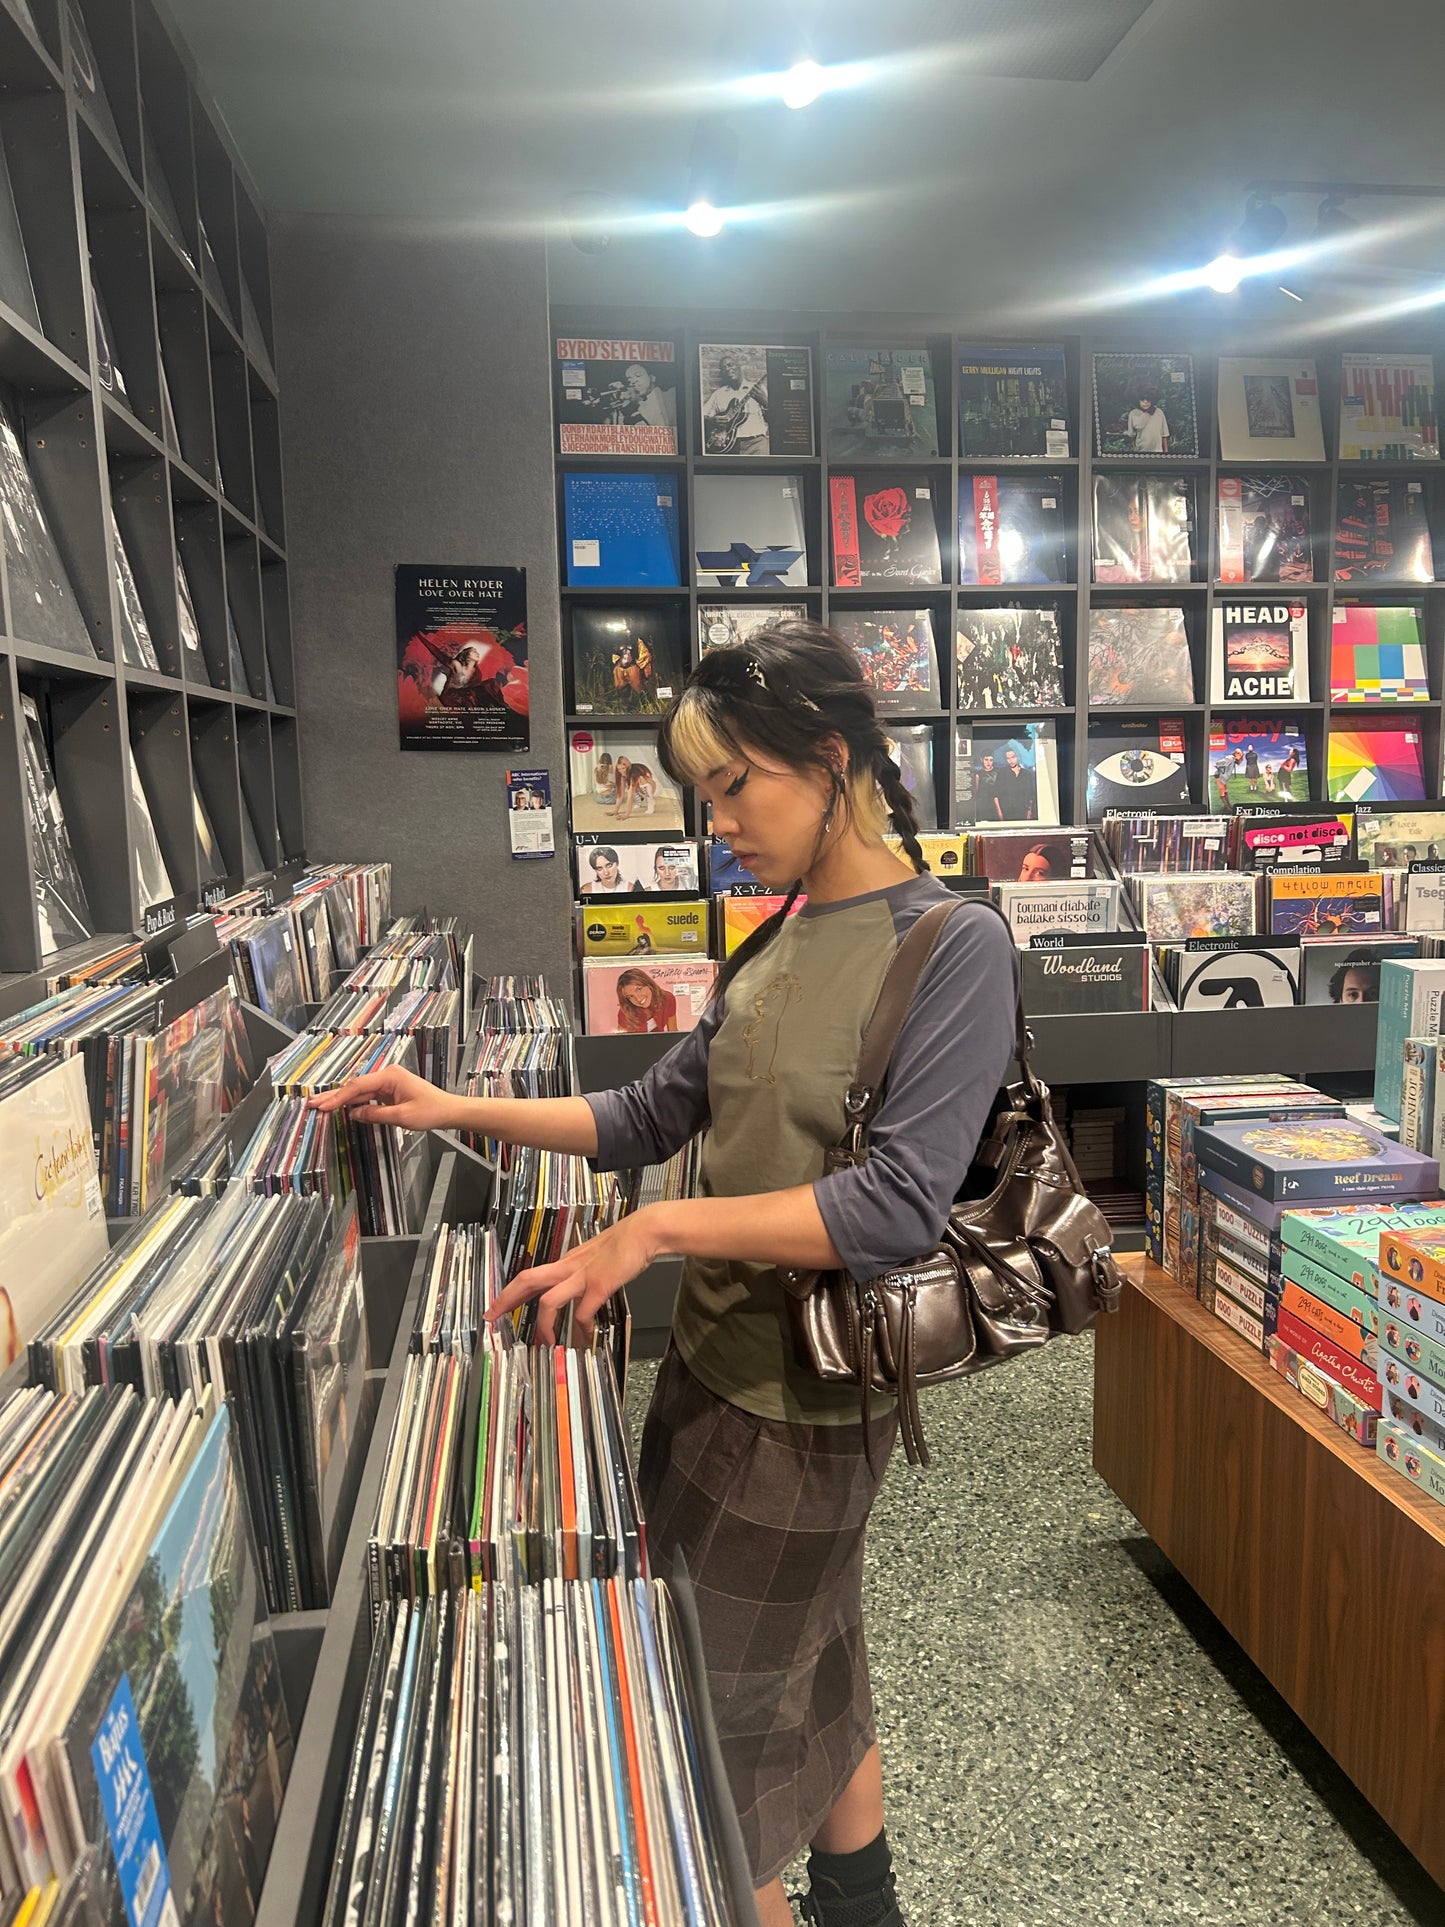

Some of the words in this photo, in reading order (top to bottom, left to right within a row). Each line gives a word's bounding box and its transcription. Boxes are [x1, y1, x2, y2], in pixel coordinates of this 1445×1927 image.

[419, 578, 458, 589] HELEN
[464, 579, 504, 590] RYDER
[419, 589, 445, 598] LOVE
[448, 590, 475, 598] OVER
[479, 590, 504, 599] HATE
[1226, 605, 1290, 624] HEAD
[1227, 677, 1291, 696] ACHE
[1228, 715, 1283, 743] glory
[1106, 808, 1157, 818] Electronic
[1255, 806, 1280, 816] Disco
[1355, 804, 1372, 814] Jazz
[1253, 834, 1286, 845] disco
[1289, 829, 1309, 841] not
[1312, 827, 1344, 839] disco
[1266, 864, 1321, 875] Compilation
[582, 896, 592, 906] T
[1017, 901, 1058, 914] toumani
[1060, 899, 1101, 912] diabate
[146, 914, 157, 934] Pop
[162, 905, 176, 925] Rock
[667, 912, 700, 926] suede
[1017, 913, 1056, 925] ballake
[1058, 912, 1101, 924] sissoko
[1033, 937, 1065, 948] World
[1189, 940, 1240, 952] Electronic
[1041, 955, 1123, 976] Woodland
[1334, 959, 1371, 968] squarepusher
[1081, 974, 1122, 982] STUDIOS
[1430, 990, 1440, 1022] Puzzle
[1428, 1023, 1438, 1038] Ma
[1407, 1077, 1418, 1117] JOHN
[1334, 1172, 1362, 1185] Reef
[1363, 1171, 1404, 1184] Dream
[1218, 1207, 1235, 1225] 1000
[1243, 1222, 1268, 1246] PUZZLE
[1348, 1216, 1411, 1235] 299
[1300, 1230, 1315, 1245] 299
[1314, 1237, 1328, 1254] DOGS
[1219, 1234, 1235, 1253] 1000
[1242, 1251, 1267, 1276] PUZZLE
[1300, 1264, 1314, 1279] 299
[1314, 1271, 1328, 1289] DOGS
[1217, 1267, 1232, 1286] 1000
[1239, 1283, 1263, 1309] PUZZLE
[1297, 1296, 1312, 1312] 299
[1311, 1305, 1324, 1322] CATS
[1216, 1298, 1232, 1317] 1000
[1238, 1315, 1262, 1341] PUZZLE
[1311, 1342, 1341, 1371] Agatha
[1341, 1365, 1375, 1394] Christie
[275, 1474, 284, 1504] SIMONA
[280, 1506, 290, 1550] CASTRICUM
[286, 1559, 299, 1613] PANIC/DESIR
